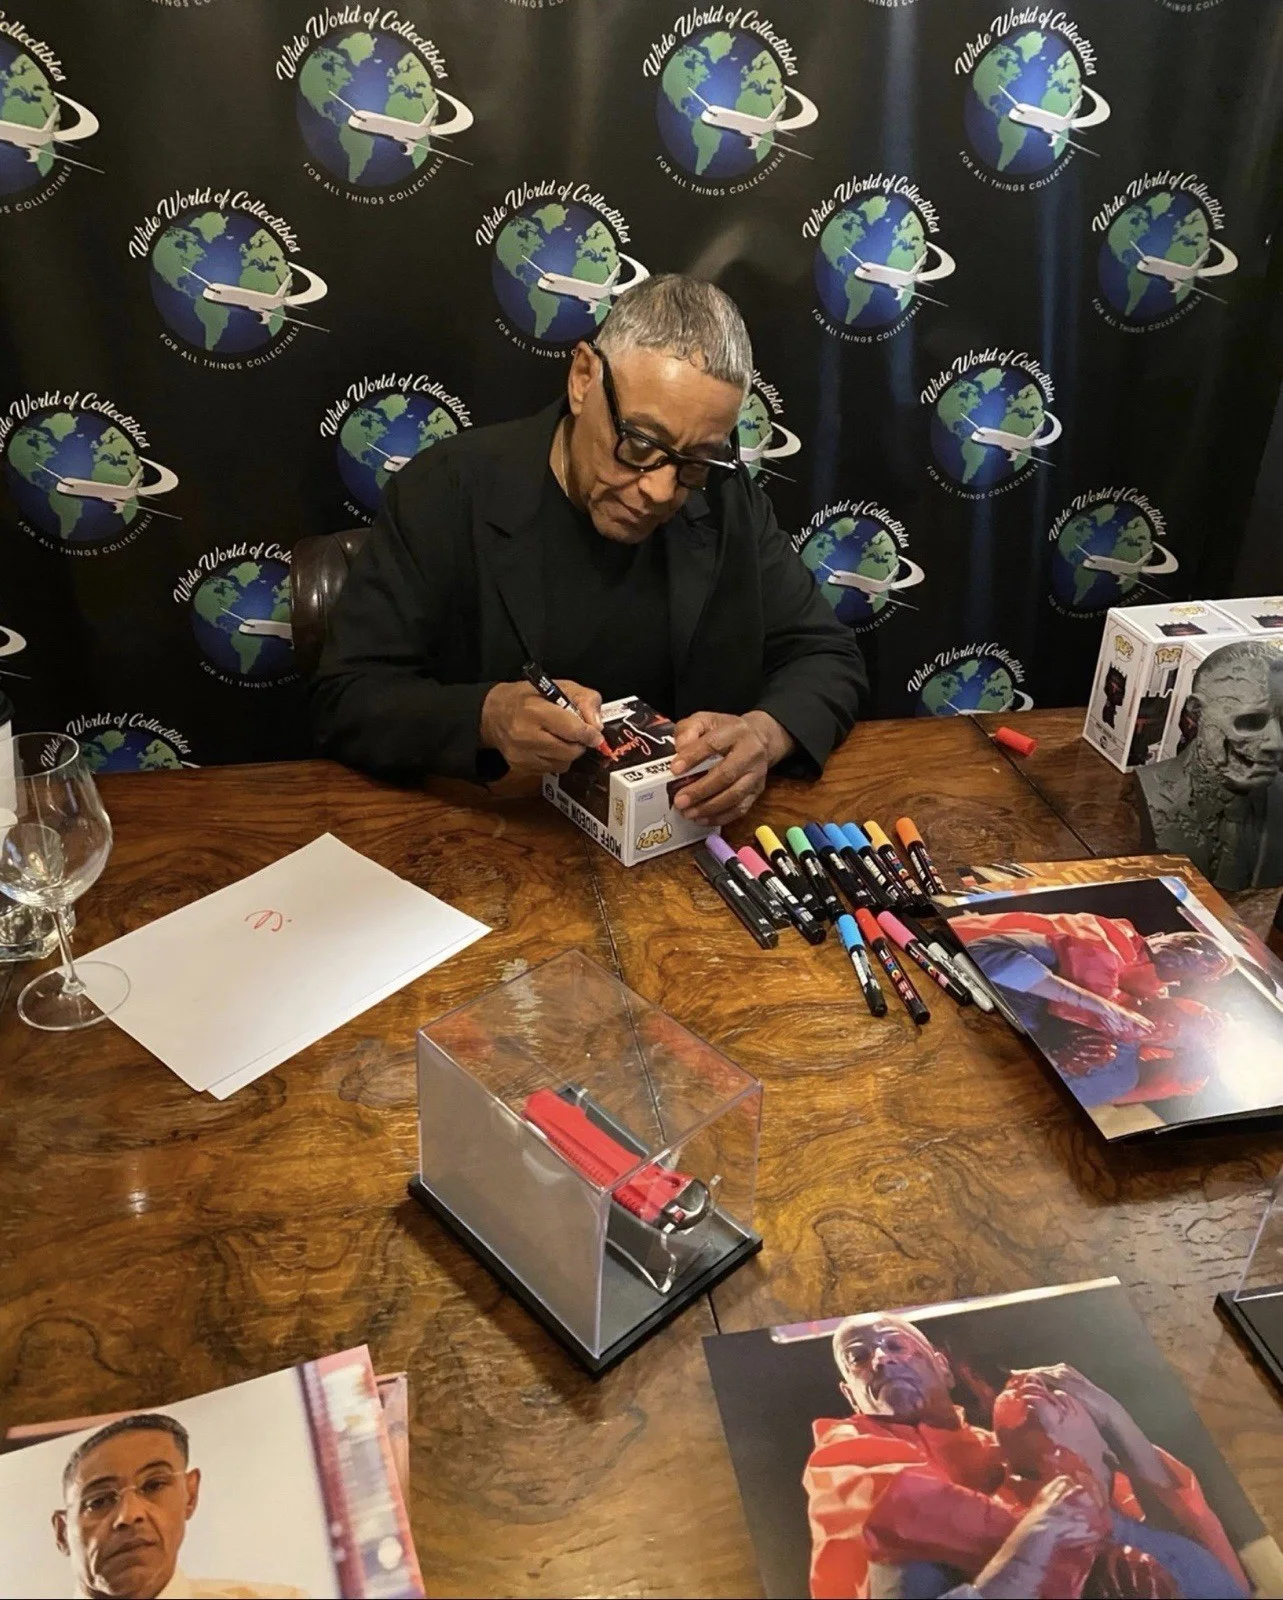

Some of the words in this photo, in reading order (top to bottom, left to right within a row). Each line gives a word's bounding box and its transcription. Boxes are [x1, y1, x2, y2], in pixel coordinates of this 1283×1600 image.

[0, 10, 66, 82] ollectibles
[276, 35, 309, 80] Wide
[306, 5, 361, 38] World
[364, 7, 380, 30] of
[380, 10, 449, 79] Collectibles
[643, 34, 676, 77] Wide
[674, 5, 724, 37] World
[725, 7, 741, 29] of
[741, 10, 798, 76] Collectibles
[955, 33, 991, 75] Wide
[991, 6, 1038, 37] World
[1038, 9, 1053, 29] of
[1050, 12, 1097, 76] Collectibles
[16, 164, 72, 212] COLLECTIBLE
[303, 162, 320, 181] FOR
[324, 182, 339, 196] ALL
[346, 193, 384, 204] THINGS
[389, 158, 443, 202] COLLECTIBLE
[656, 155, 671, 174] FOR
[672, 174, 686, 188] ALL
[691, 184, 725, 196] THINGS
[730, 152, 786, 193] COLLECTIBLE
[960, 151, 973, 169] FOR
[974, 169, 987, 182] ALL
[992, 180, 1025, 191] THINGS
[1029, 149, 1076, 190] COLLECTIBLE
[129, 216, 160, 259] Wide
[157, 187, 211, 219] World
[214, 189, 230, 209] of
[231, 190, 300, 253] Collectibles
[476, 206, 508, 246] Wide
[505, 180, 556, 209] World
[557, 181, 574, 201] of
[573, 183, 631, 244] Collectibles
[802, 199, 835, 238] Wide
[834, 173, 882, 203] World
[882, 174, 896, 194] of
[894, 176, 940, 233] Collectibles
[1092, 196, 1126, 232] Wide
[1126, 170, 1170, 198] World
[1169, 172, 1184, 190] of
[1180, 174, 1225, 230] Collectibles
[160, 333, 178, 351] FOR
[181, 350, 198, 364] ALL
[203, 360, 242, 370] THINGS
[247, 326, 300, 367] COLLECTIBLE
[495, 318, 509, 336] FOR
[512, 336, 526, 350] ALL
[531, 347, 566, 358] THINGS
[812, 308, 824, 325] FOR
[825, 324, 837, 336] ALL
[840, 333, 872, 343] THINGS
[876, 301, 923, 341] COLLECTIBLE
[921, 371, 952, 404] Wide
[952, 348, 998, 373] World
[999, 350, 1014, 366] of
[1012, 352, 1055, 403] Collectibles
[10, 391, 60, 419] World
[64, 391, 79, 410] of
[80, 393, 150, 449] Collectibles
[320, 400, 350, 437] Wide
[347, 373, 395, 401] World
[398, 374, 412, 391] of
[413, 374, 473, 428] Collectibles
[927, 466, 939, 481] FOR
[940, 482, 952, 493] ALL
[957, 491, 986, 499] THINGS
[989, 464, 1039, 497] COLLECTIBLE
[18, 521, 36, 538] FOR
[39, 538, 53, 550] ALL
[60, 547, 98, 556] THINGS
[103, 513, 154, 553] COLLECTIBLE
[811, 500, 850, 527] World
[851, 501, 864, 516] of
[862, 502, 909, 549] Collectibles
[1049, 508, 1071, 541] Wide
[1072, 486, 1113, 510] World
[1112, 487, 1125, 502] of
[1122, 488, 1167, 536] Collectibles
[174, 570, 201, 603] Wide
[199, 543, 246, 570] World
[250, 542, 264, 559] of
[907, 663, 936, 692] Wide
[935, 643, 976, 667] World
[975, 642, 987, 657] of
[984, 642, 1025, 683] Collectibles
[66, 712, 111, 736] World
[114, 712, 128, 728] of
[128, 713, 192, 754] Collectibles
